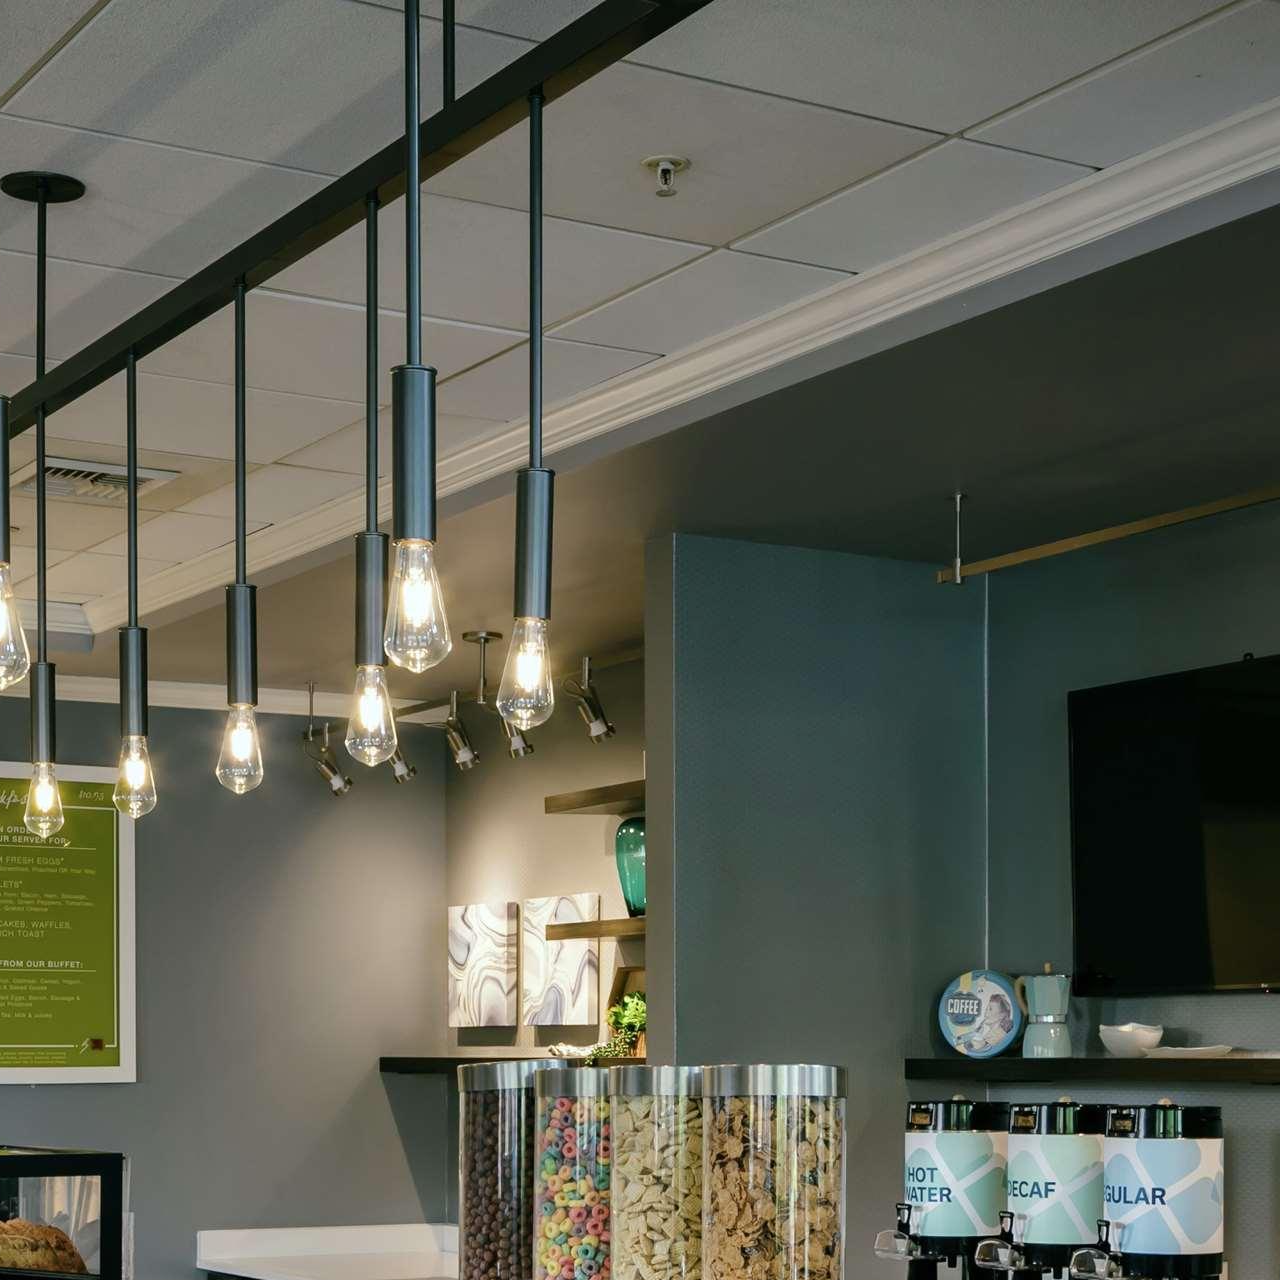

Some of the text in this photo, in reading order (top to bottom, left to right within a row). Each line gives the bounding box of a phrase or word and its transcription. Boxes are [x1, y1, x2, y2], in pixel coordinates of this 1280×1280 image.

[7, 826, 30, 834] ORDE
[12, 835, 47, 844] SERVER
[6, 856, 34, 865] FRESH
[18, 930, 45, 938] TOAST
[26, 960, 45, 968] OUR
[47, 961, 84, 969] BUFFET:
[947, 998, 979, 1015] COFFEE
[907, 1167, 938, 1183] HOT
[1007, 1180, 1057, 1199] DECAF
[1104, 1183, 1167, 1205] GULAR
